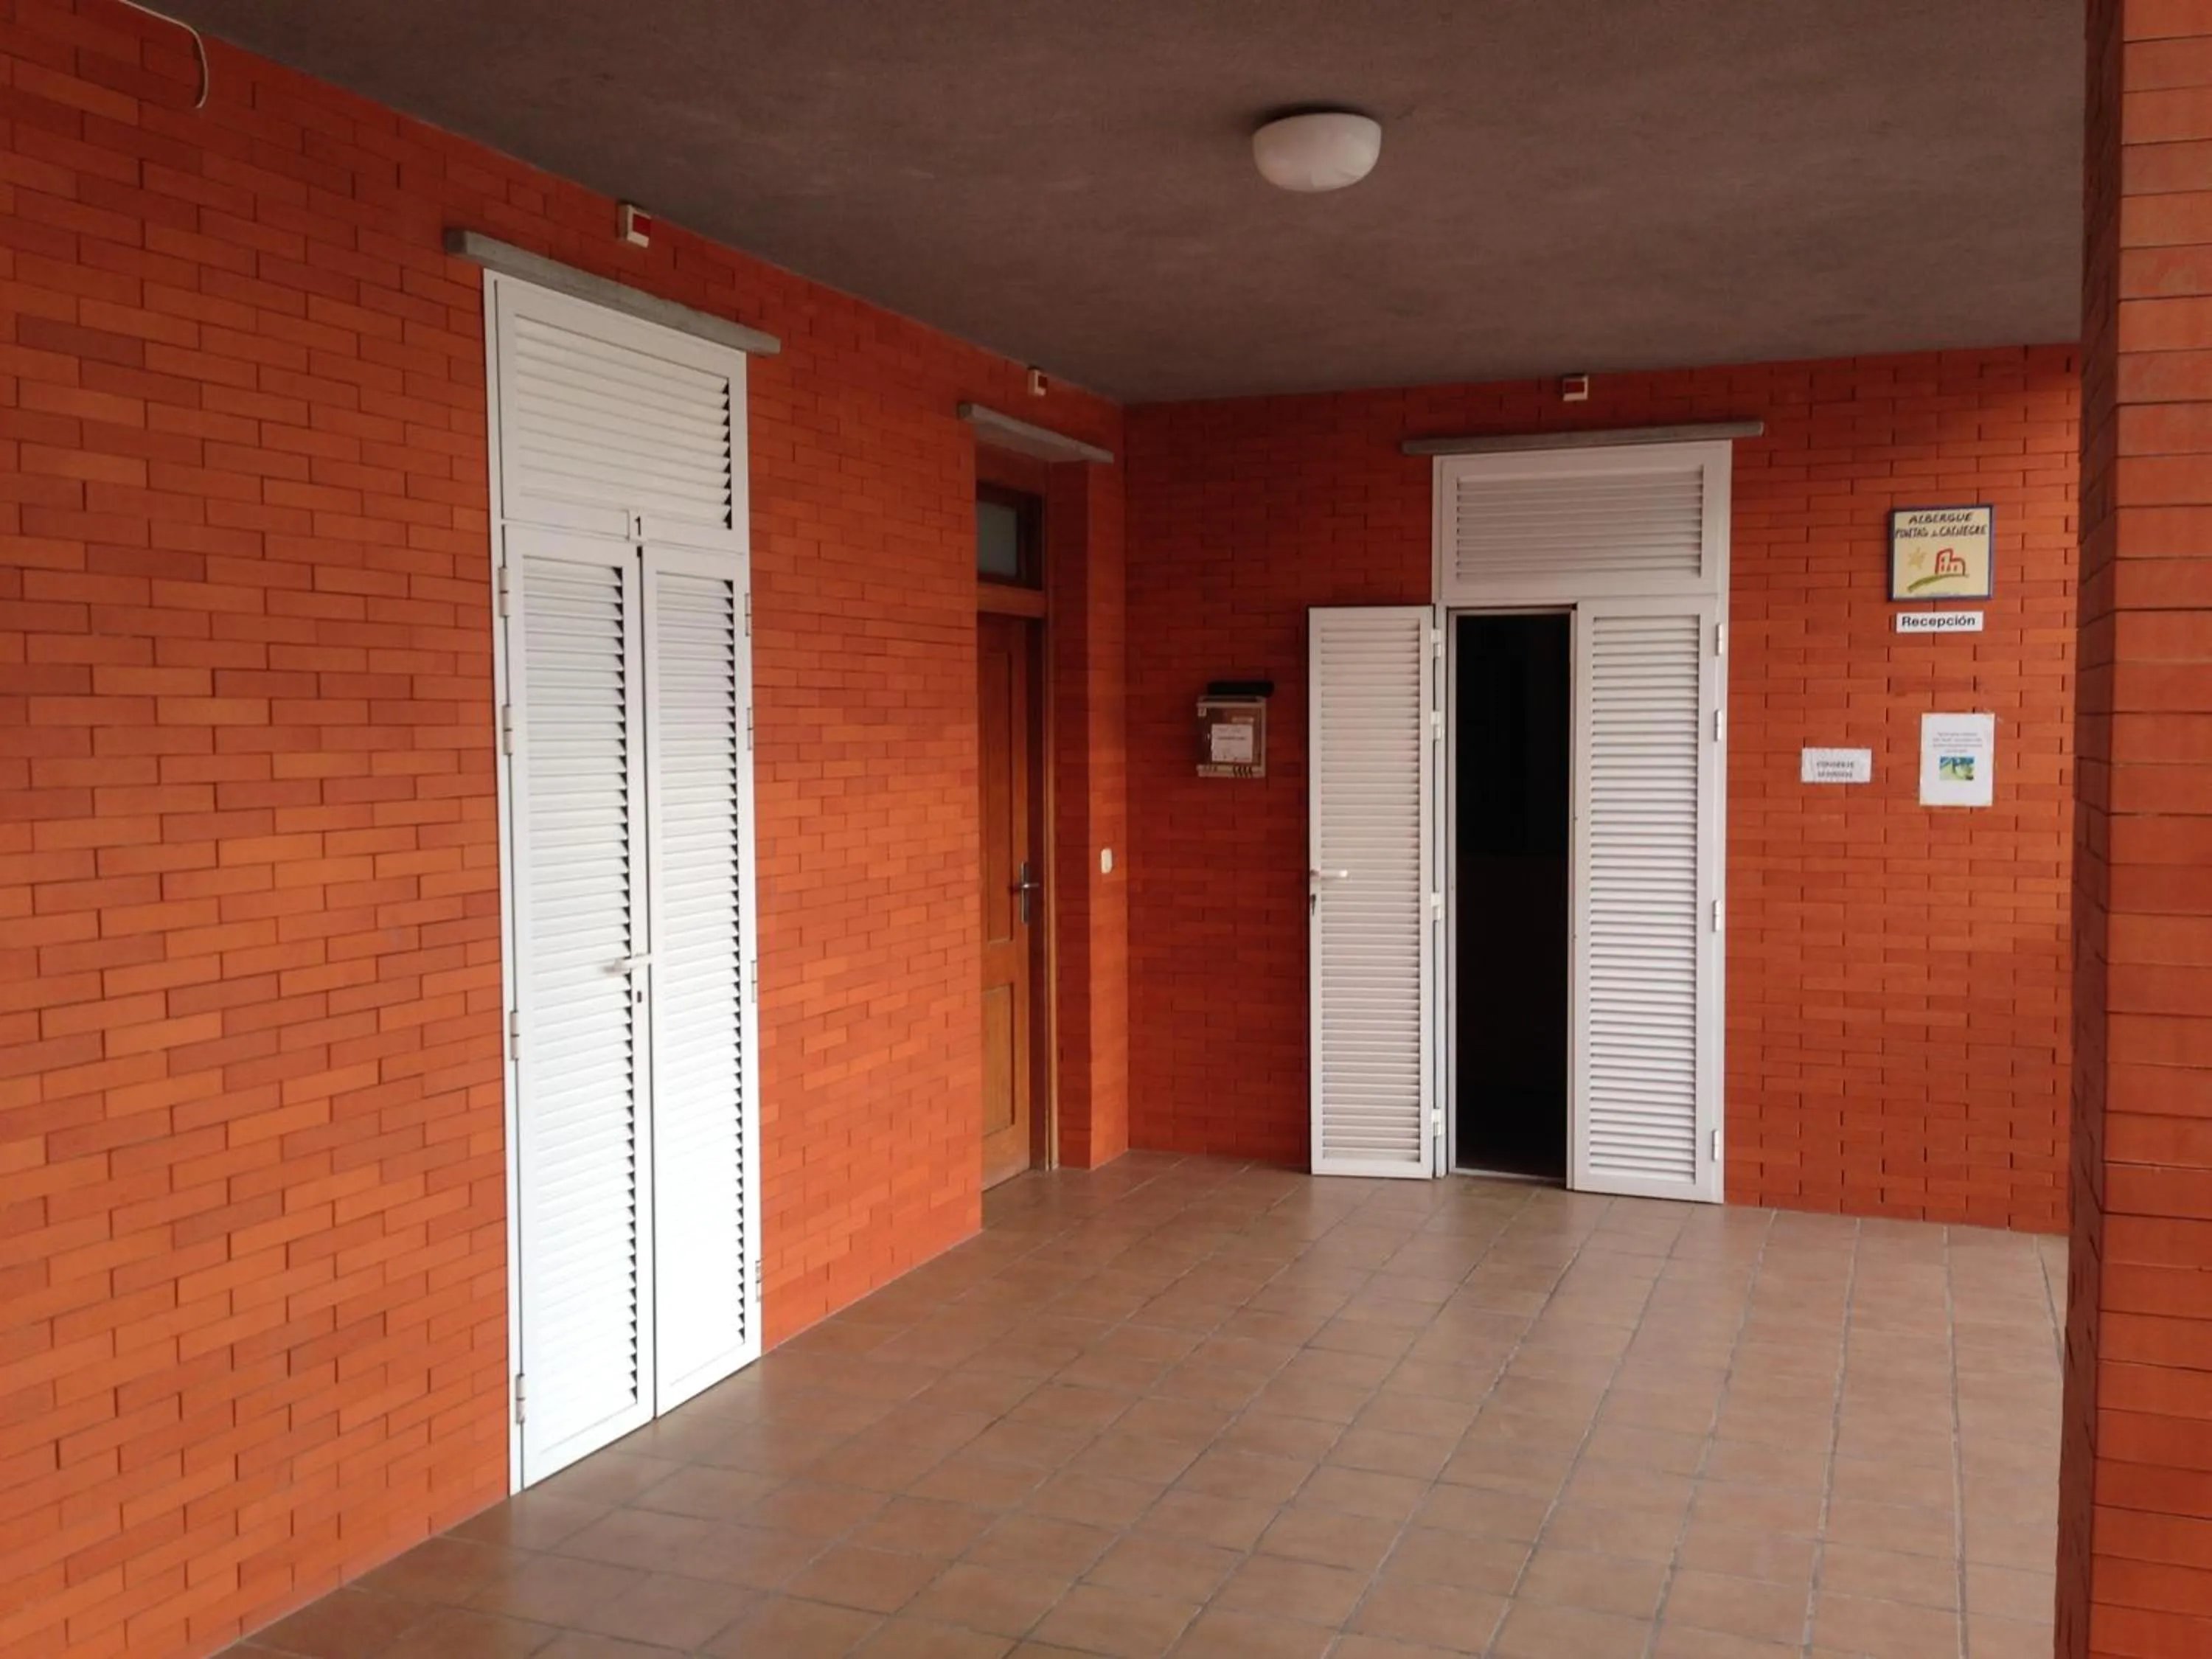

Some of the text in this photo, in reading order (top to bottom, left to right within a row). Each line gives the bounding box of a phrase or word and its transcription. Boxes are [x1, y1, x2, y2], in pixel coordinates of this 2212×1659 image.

[1908, 512, 1972, 524] ALBERGUE
[634, 516, 641, 537] 1
[1902, 616, 1975, 628] Recepción
